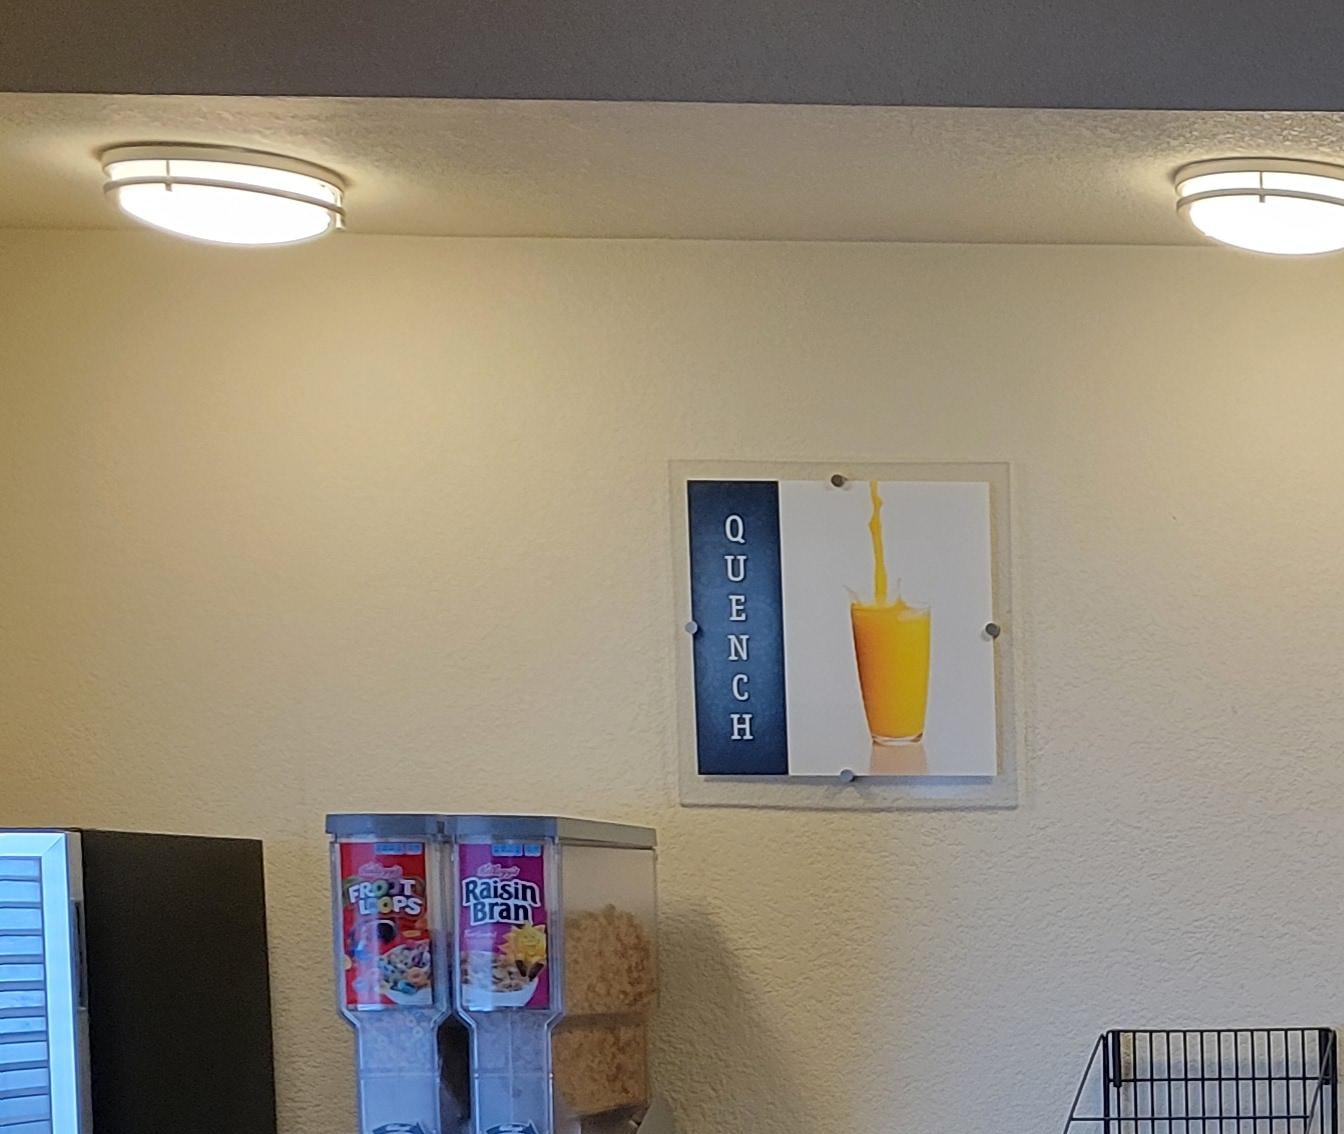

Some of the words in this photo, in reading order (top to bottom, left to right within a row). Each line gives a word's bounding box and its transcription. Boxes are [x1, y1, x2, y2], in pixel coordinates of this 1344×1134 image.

[724, 515, 754, 740] QUENCH
[463, 878, 540, 906] Raisin
[472, 901, 532, 924] Bran
